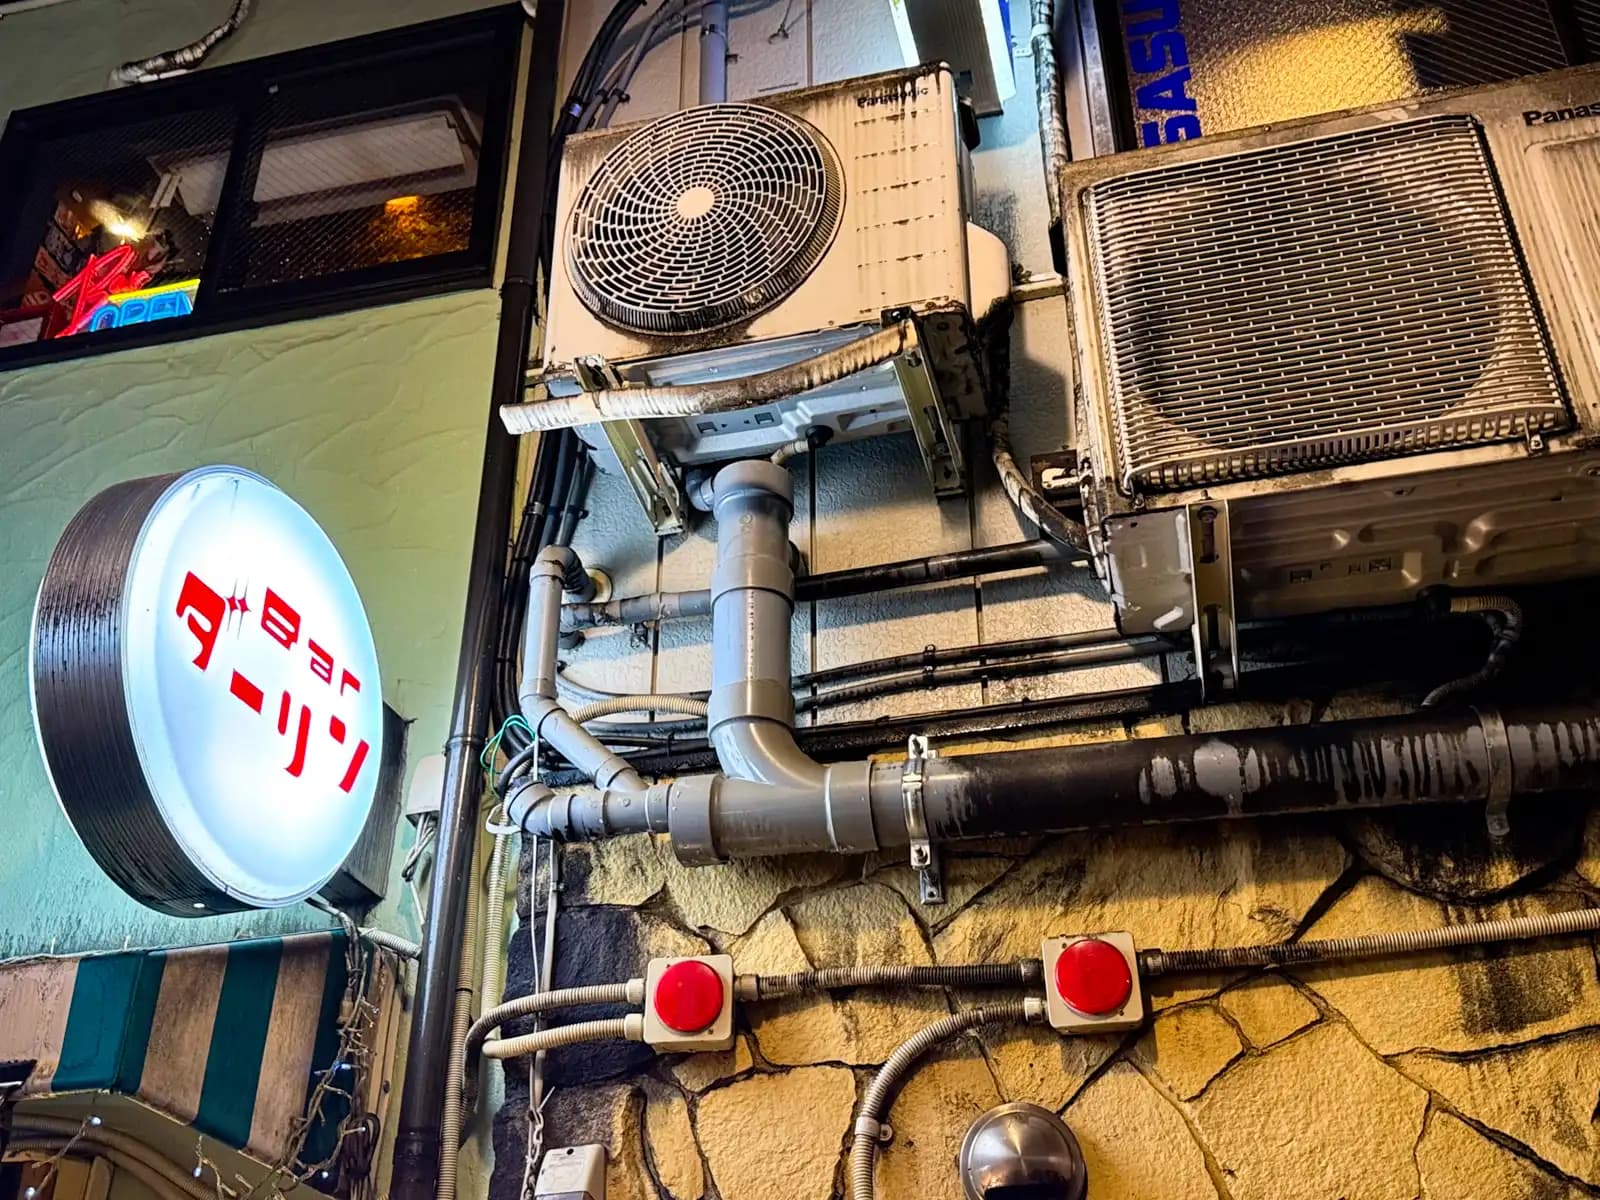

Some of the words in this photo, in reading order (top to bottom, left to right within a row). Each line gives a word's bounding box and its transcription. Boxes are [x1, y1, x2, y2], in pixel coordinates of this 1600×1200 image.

[175, 570, 370, 794] ダーリン
[261, 587, 361, 697] Bar
